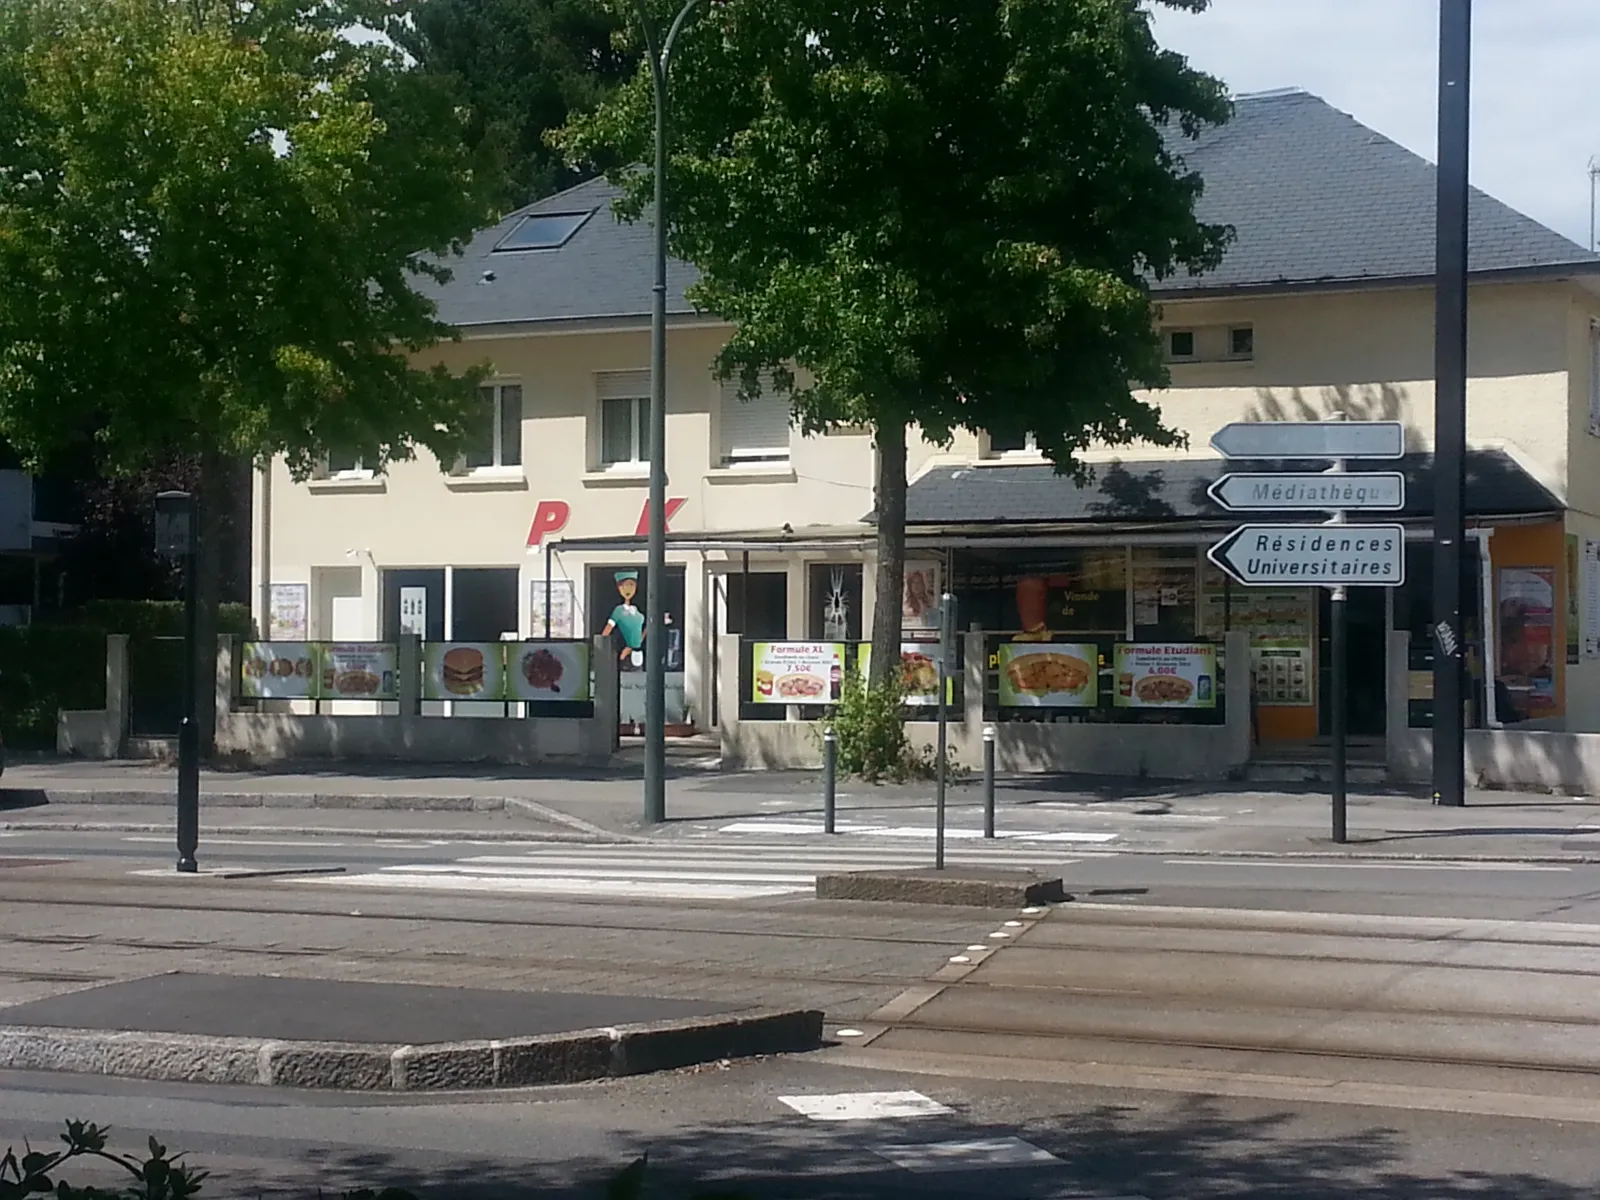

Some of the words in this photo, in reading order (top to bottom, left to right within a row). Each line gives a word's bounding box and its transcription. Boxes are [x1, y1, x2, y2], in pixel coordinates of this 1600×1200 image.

[527, 500, 570, 546] P
[1256, 535, 1393, 552] Résidences
[1247, 558, 1392, 575] Universitaires
[771, 645, 809, 653] Formule
[812, 645, 824, 653] XL
[1117, 645, 1162, 654] Formule
[1164, 646, 1212, 655] Etudiant
